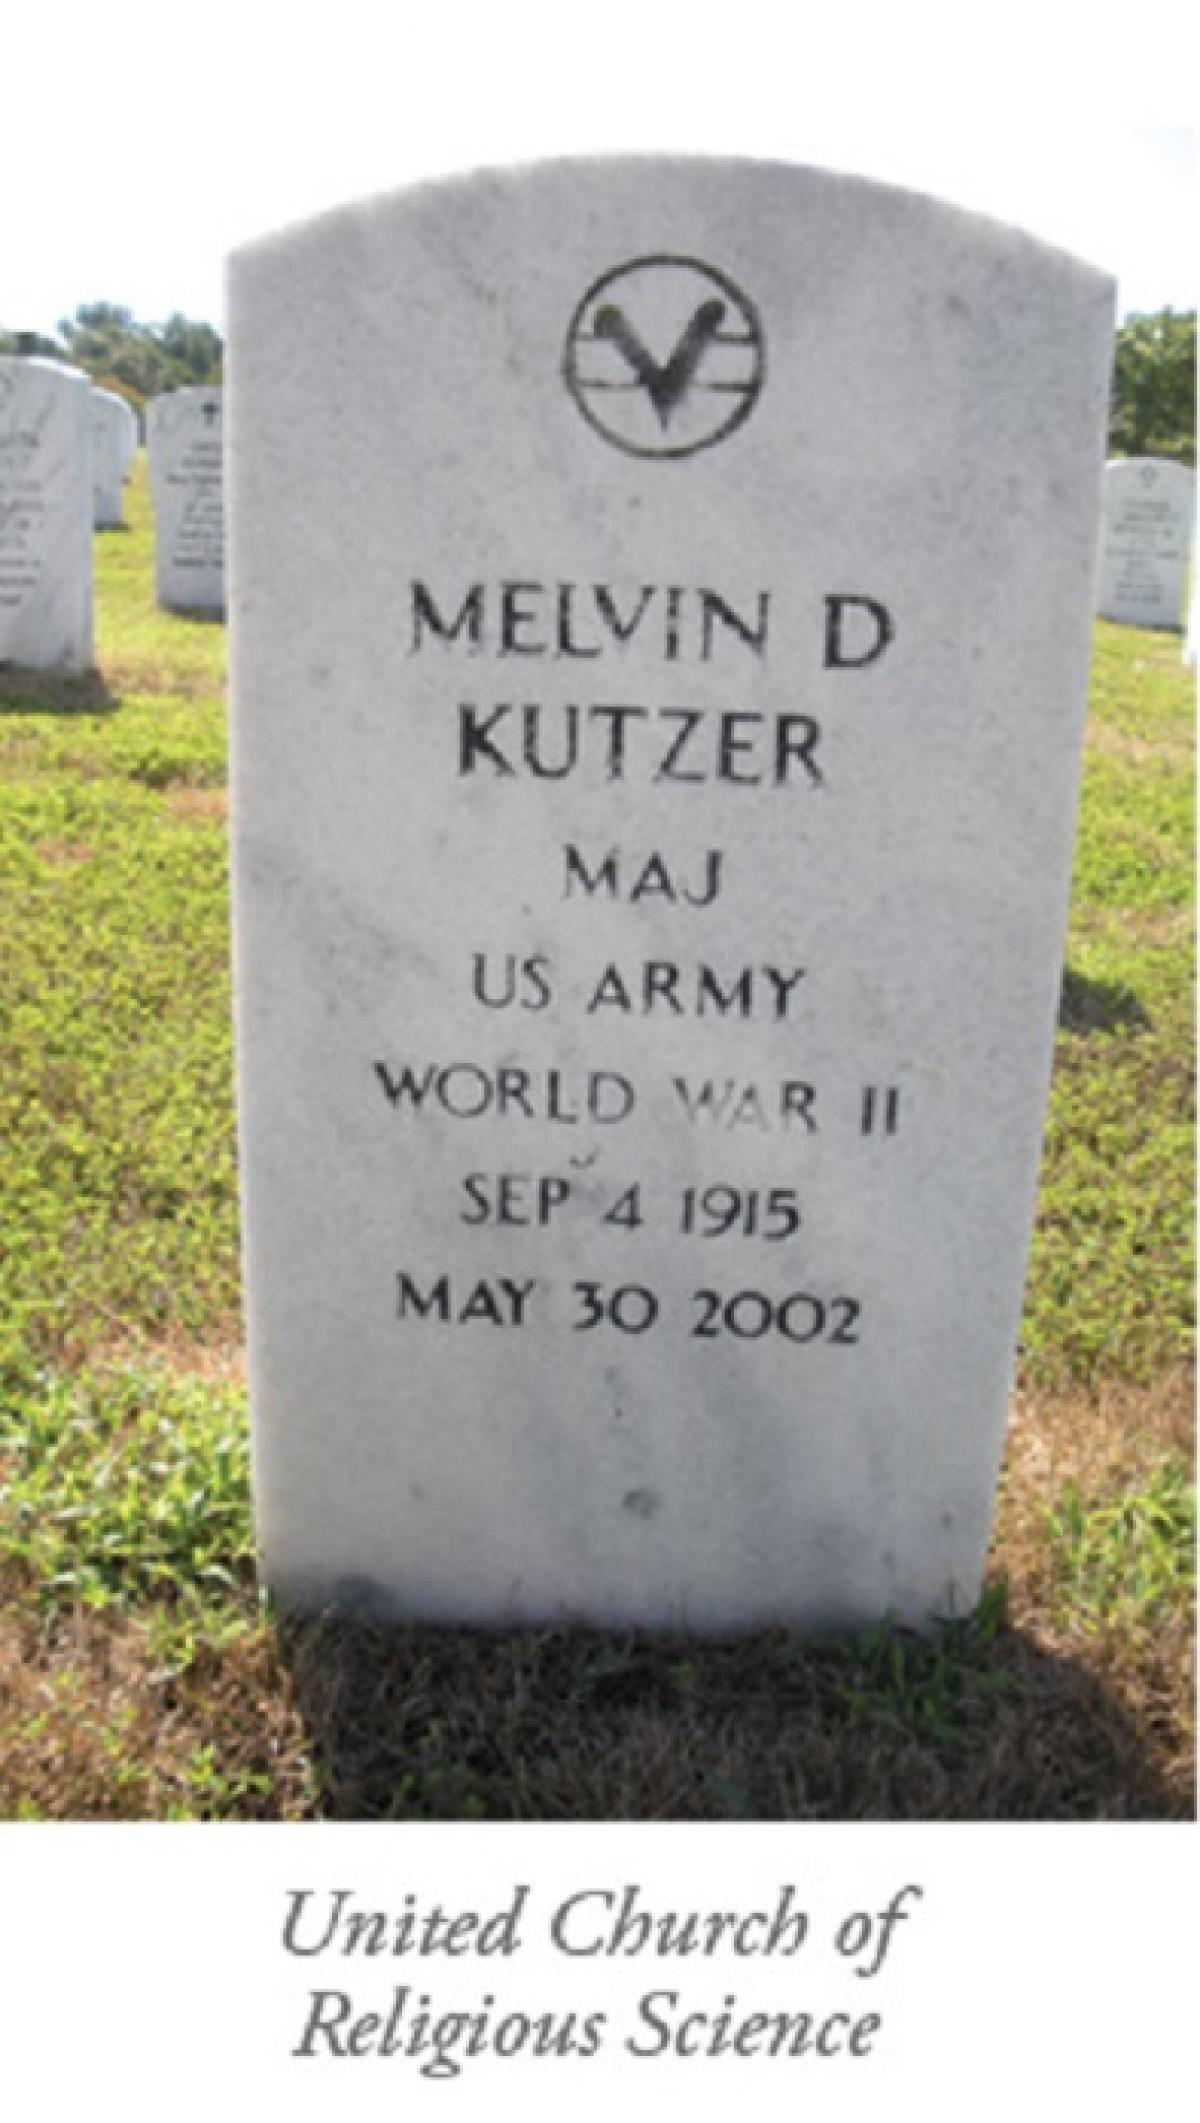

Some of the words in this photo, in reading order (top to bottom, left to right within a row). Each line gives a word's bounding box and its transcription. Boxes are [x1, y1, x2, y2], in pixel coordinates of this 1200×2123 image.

[408, 579, 772, 664] MELVIN
[823, 593, 895, 670] D
[459, 703, 826, 789] KUTZER
[563, 843, 723, 907] MAJ
[471, 952, 552, 1012] US
[587, 960, 806, 1019] ARMY
[372, 1060, 636, 1124] WORLD
[673, 1076, 819, 1133] WAR
[861, 1085, 900, 1137] II
[460, 1172, 571, 1227] SEP
[604, 1181, 643, 1230] 4
[681, 1184, 802, 1243] 1915
[396, 1271, 536, 1327] MAY
[572, 1280, 660, 1335] 30
[690, 1289, 862, 1345] 2002
